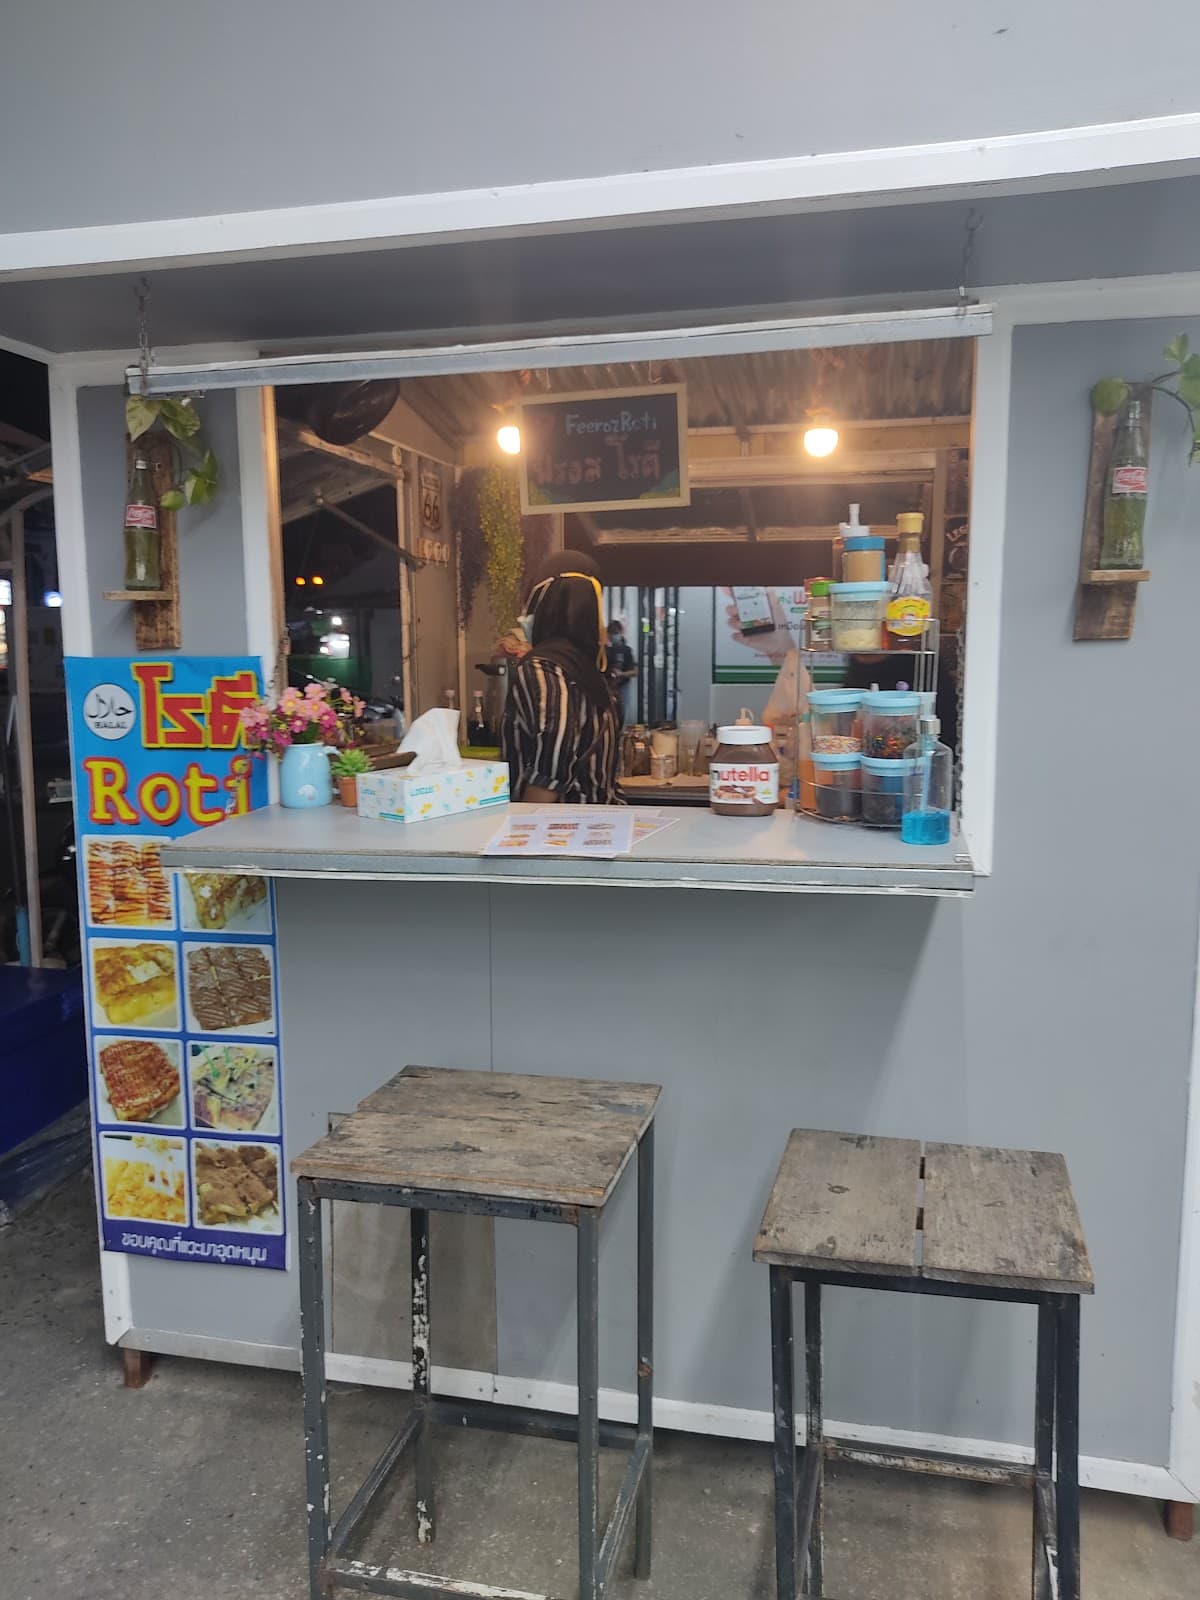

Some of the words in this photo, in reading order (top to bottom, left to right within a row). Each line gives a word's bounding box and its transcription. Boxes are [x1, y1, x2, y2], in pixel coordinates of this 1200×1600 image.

[87, 693, 134, 719] حلال
[711, 766, 770, 782] nutella
[83, 756, 253, 826] Roti
